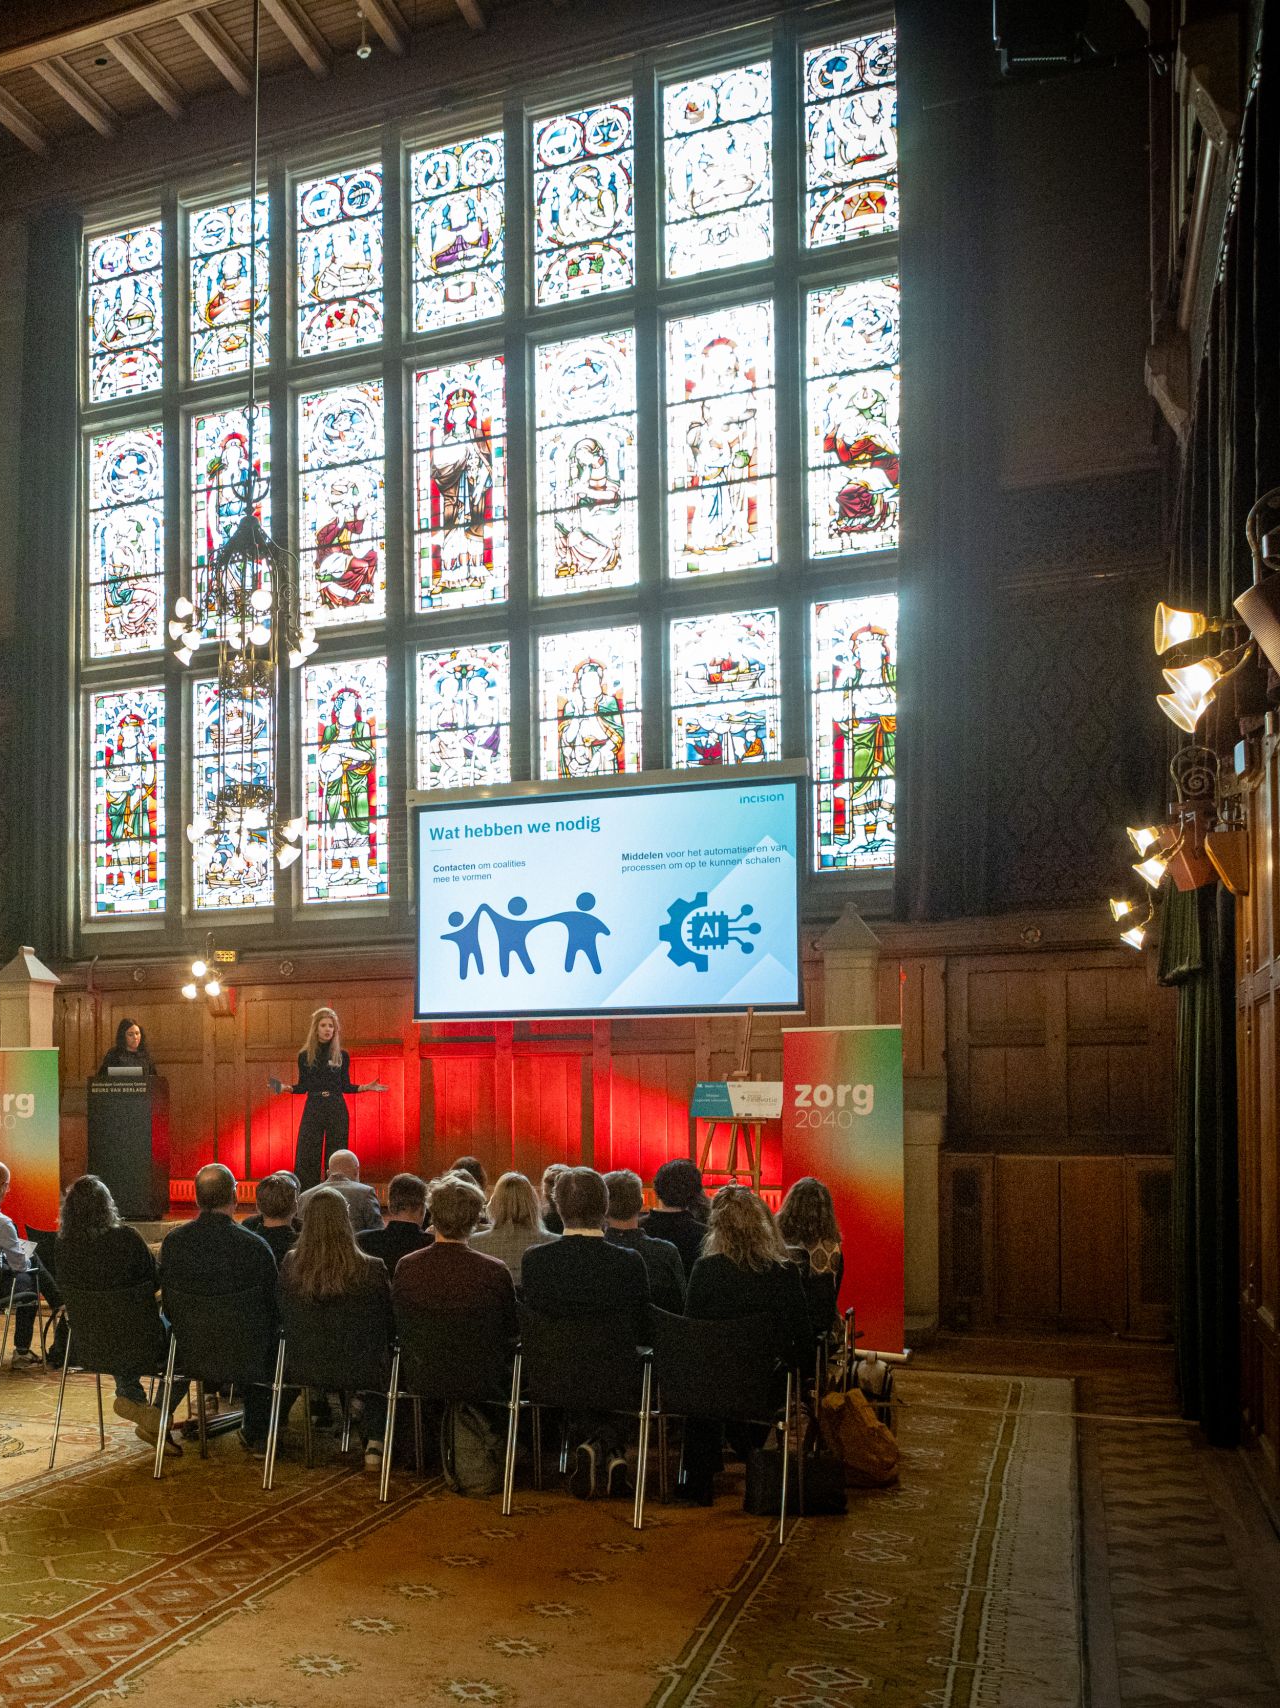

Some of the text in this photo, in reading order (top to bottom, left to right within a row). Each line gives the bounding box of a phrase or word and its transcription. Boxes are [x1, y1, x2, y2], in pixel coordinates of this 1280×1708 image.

[739, 792, 785, 804] incision
[429, 816, 601, 841] Wat hebben we nodig
[621, 843, 788, 861] Middelen voor het automatiseren van
[433, 860, 526, 873] Contacten om coalities
[621, 855, 781, 874] processen om op te kunnen schalen
[433, 873, 492, 884] mee te vormen
[698, 922, 720, 939] AI
[794, 1083, 874, 1116] zorg
[795, 1109, 853, 1129] 2040
